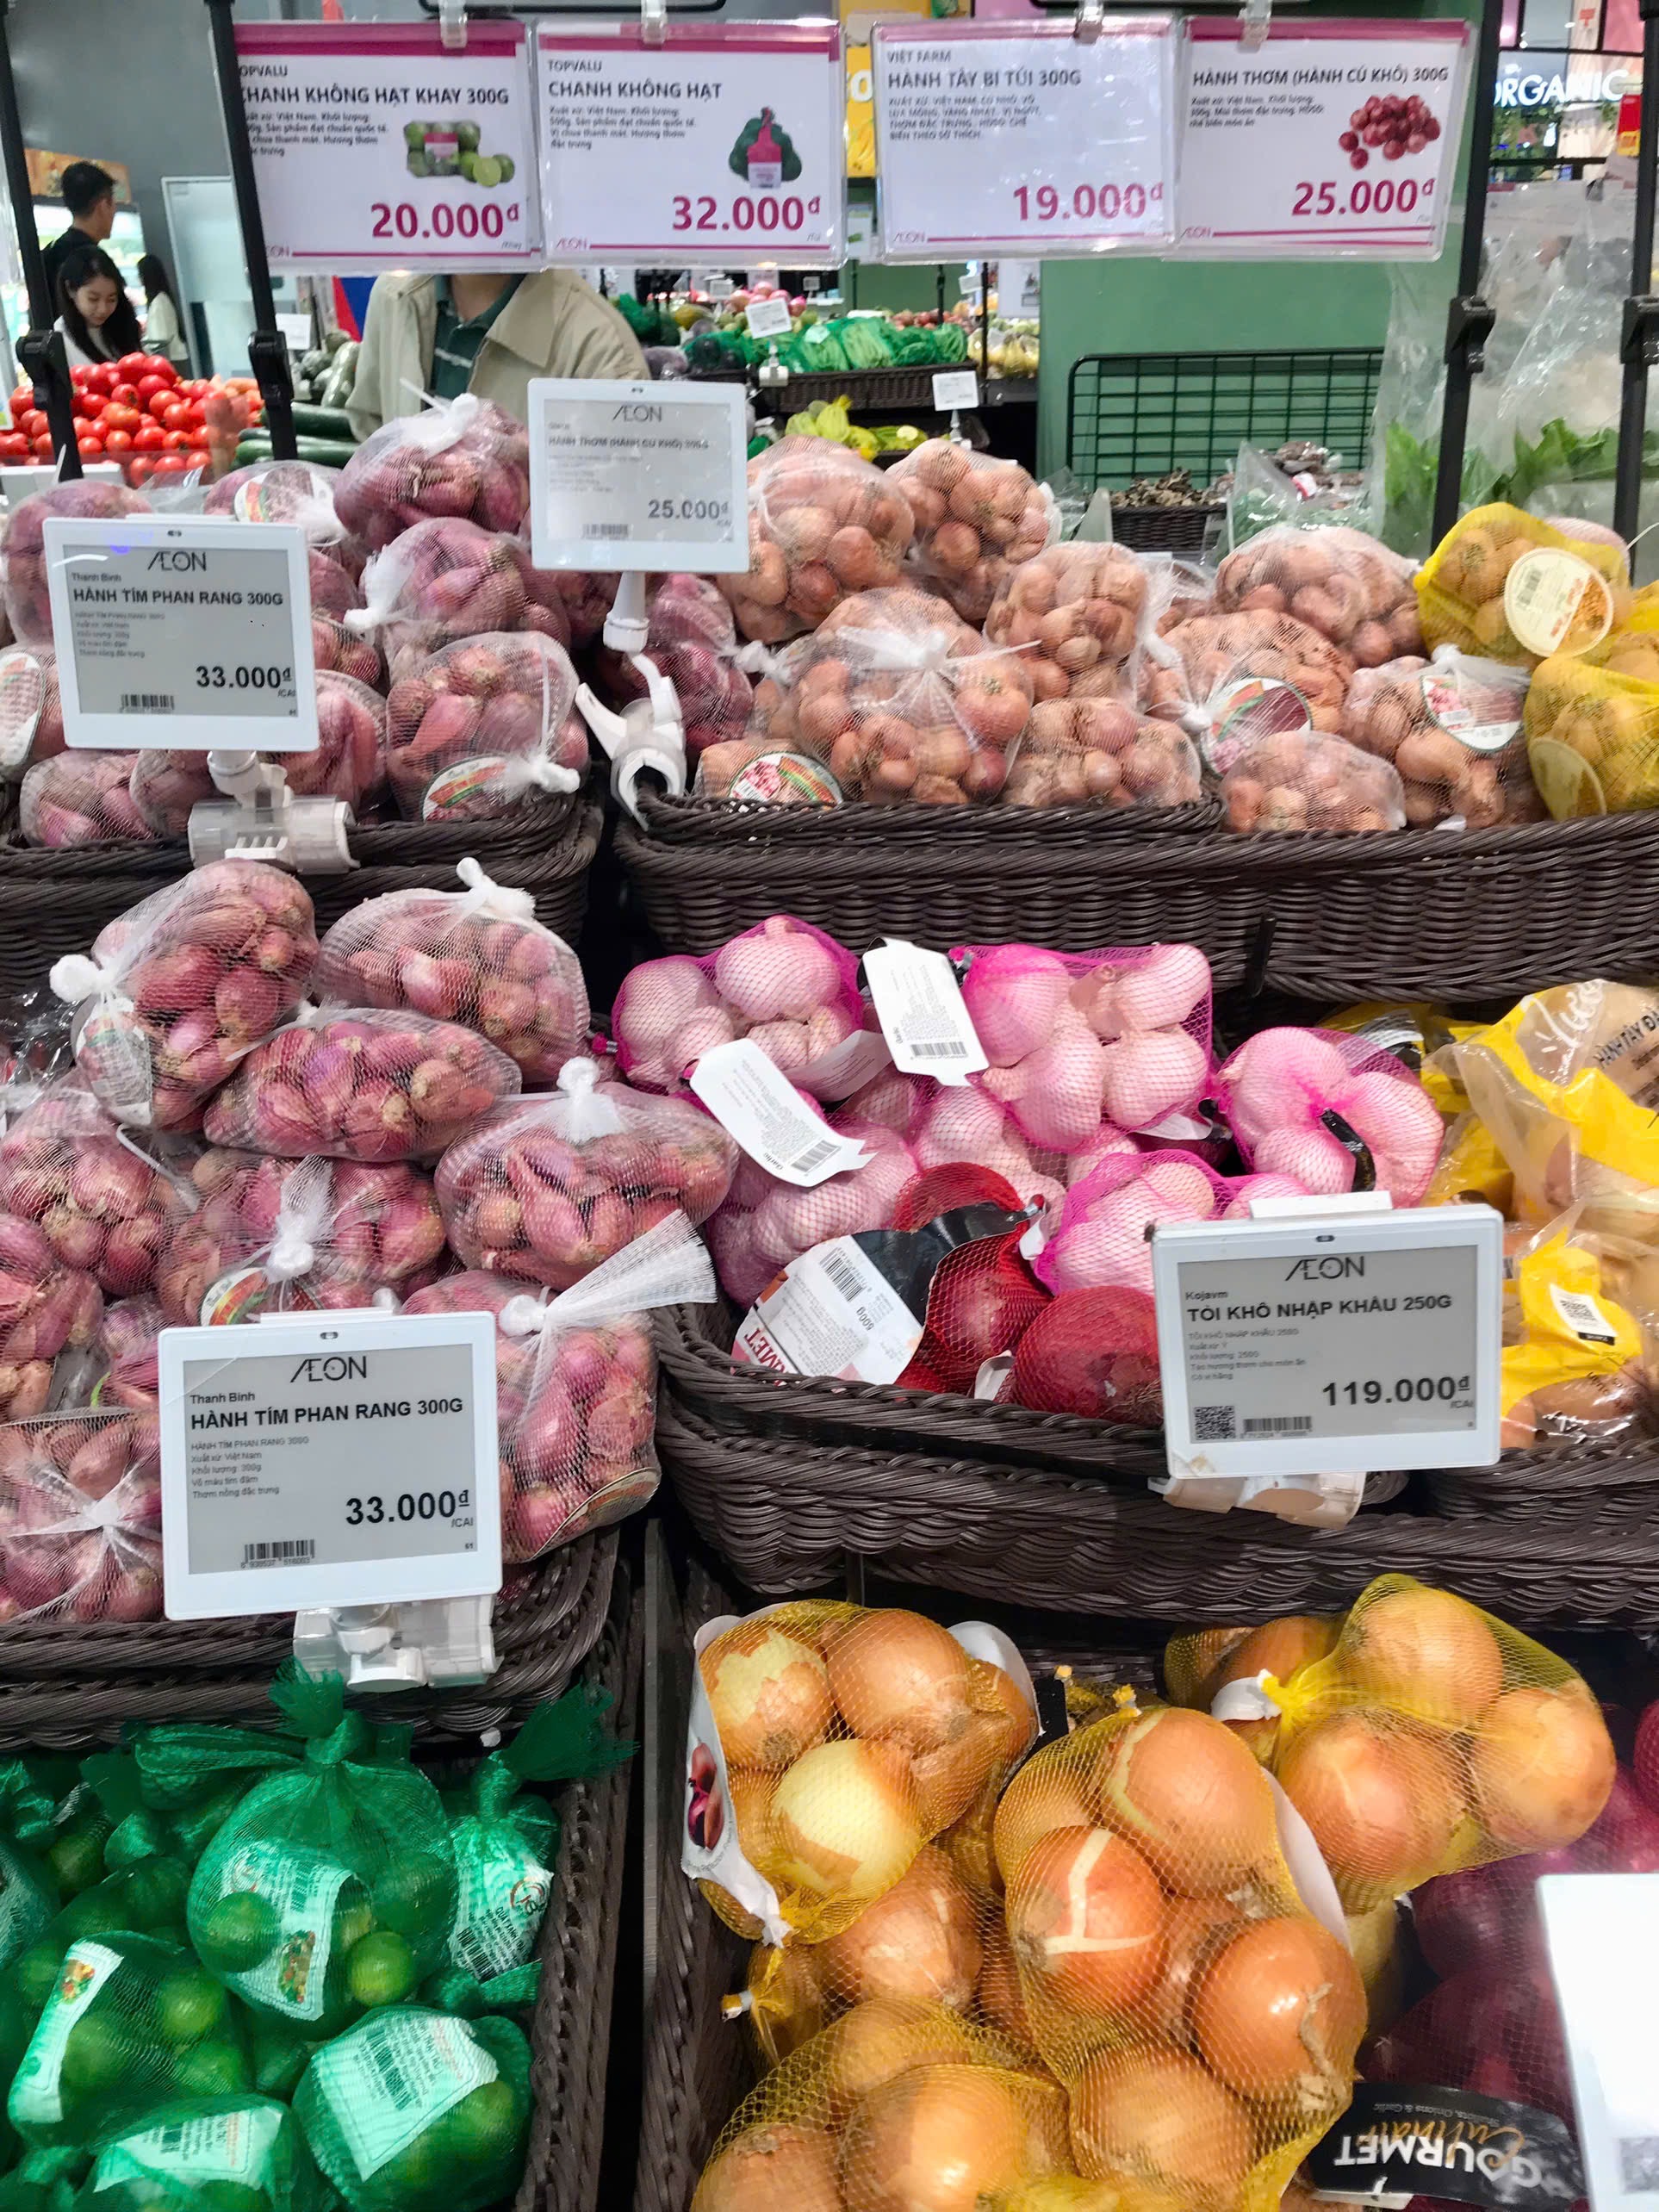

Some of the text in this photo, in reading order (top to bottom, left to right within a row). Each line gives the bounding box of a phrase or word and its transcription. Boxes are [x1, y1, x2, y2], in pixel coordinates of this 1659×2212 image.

[240, 65, 288, 76] OPVALU
[548, 59, 603, 72] TOPVALU
[1193, 67, 1238, 87] HÀNH
[1243, 69, 1289, 86] THƠM
[1294, 65, 1342, 87] (HÀNH
[1413, 66, 1449, 83] 300G
[888, 70, 941, 89] HÀNH
[949, 67, 977, 87] TÂY
[1006, 65, 1033, 87] TÚI
[1038, 69, 1082, 86] 300G
[242, 83, 508, 108] HANH KHÔNG HẠT KHAY 300G
[549, 78, 723, 103] CHANH KHÔNG HẠT
[73, 586, 283, 606] HÀNH TÍM PHAN RANG 300G
[1227, 1302, 1271, 1320] KHÔ
[1277, 1299, 1332, 1320] NHẬP
[1402, 1295, 1452, 1311] 250G
[190, 1394, 226, 1404] Thanh
[191, 1397, 463, 1430] HÀNH TÍM PHAN RANG 300G
[1373, 2103, 1403, 2114] Garlic
[1415, 2104, 1454, 2118] Onions
[1334, 2135, 1542, 2189] GOURMET
